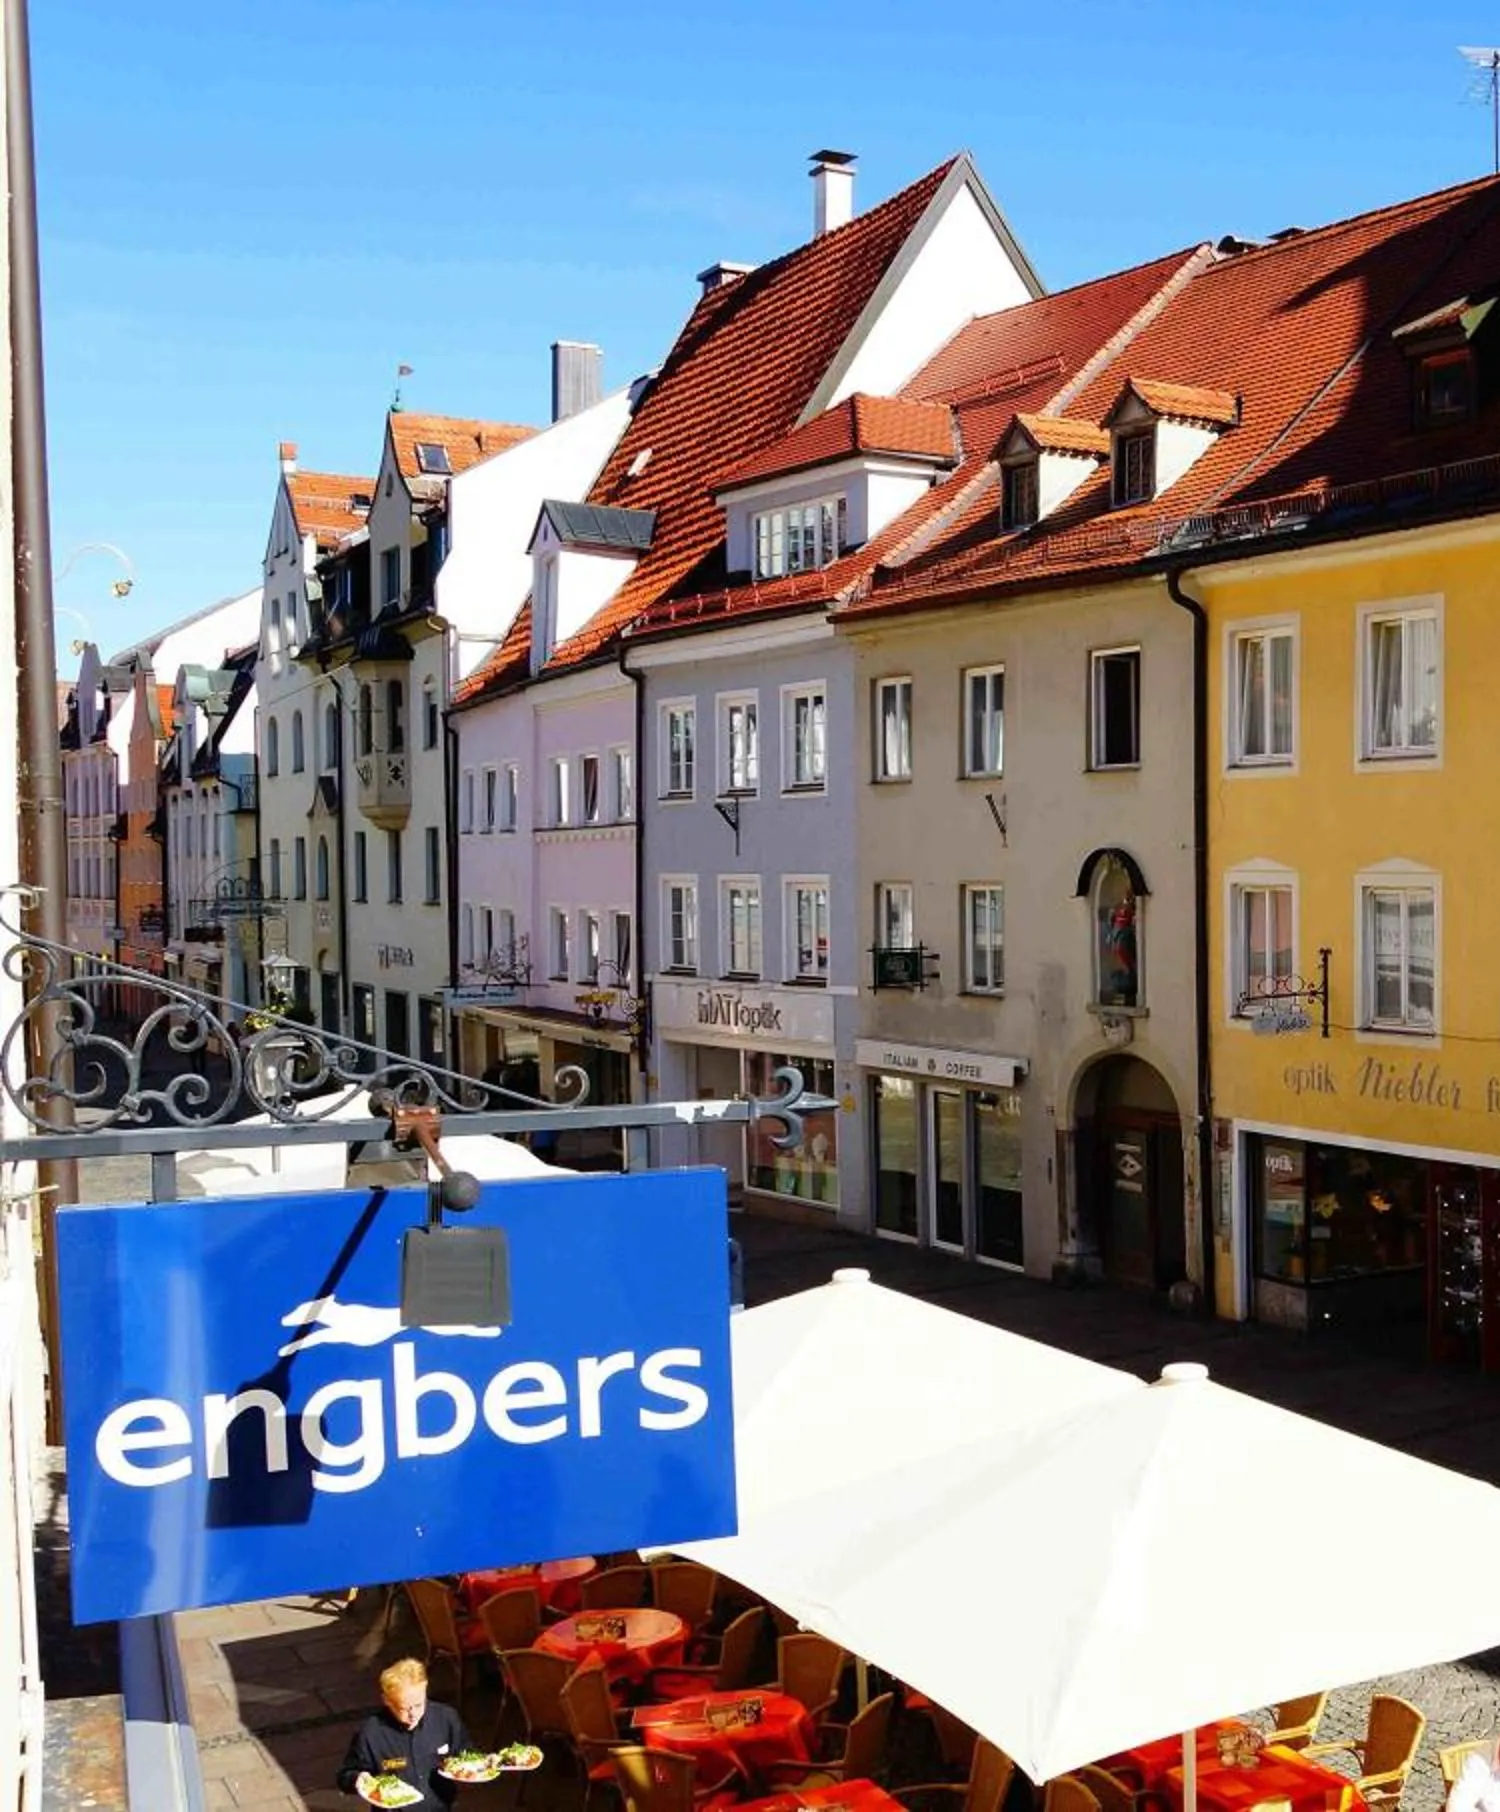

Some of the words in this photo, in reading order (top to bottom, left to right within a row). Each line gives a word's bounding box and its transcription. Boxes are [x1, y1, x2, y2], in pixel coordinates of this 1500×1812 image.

[1283, 1062, 1336, 1096] optik
[1360, 1056, 1461, 1110] Niebler
[95, 1343, 709, 1494] engbers
